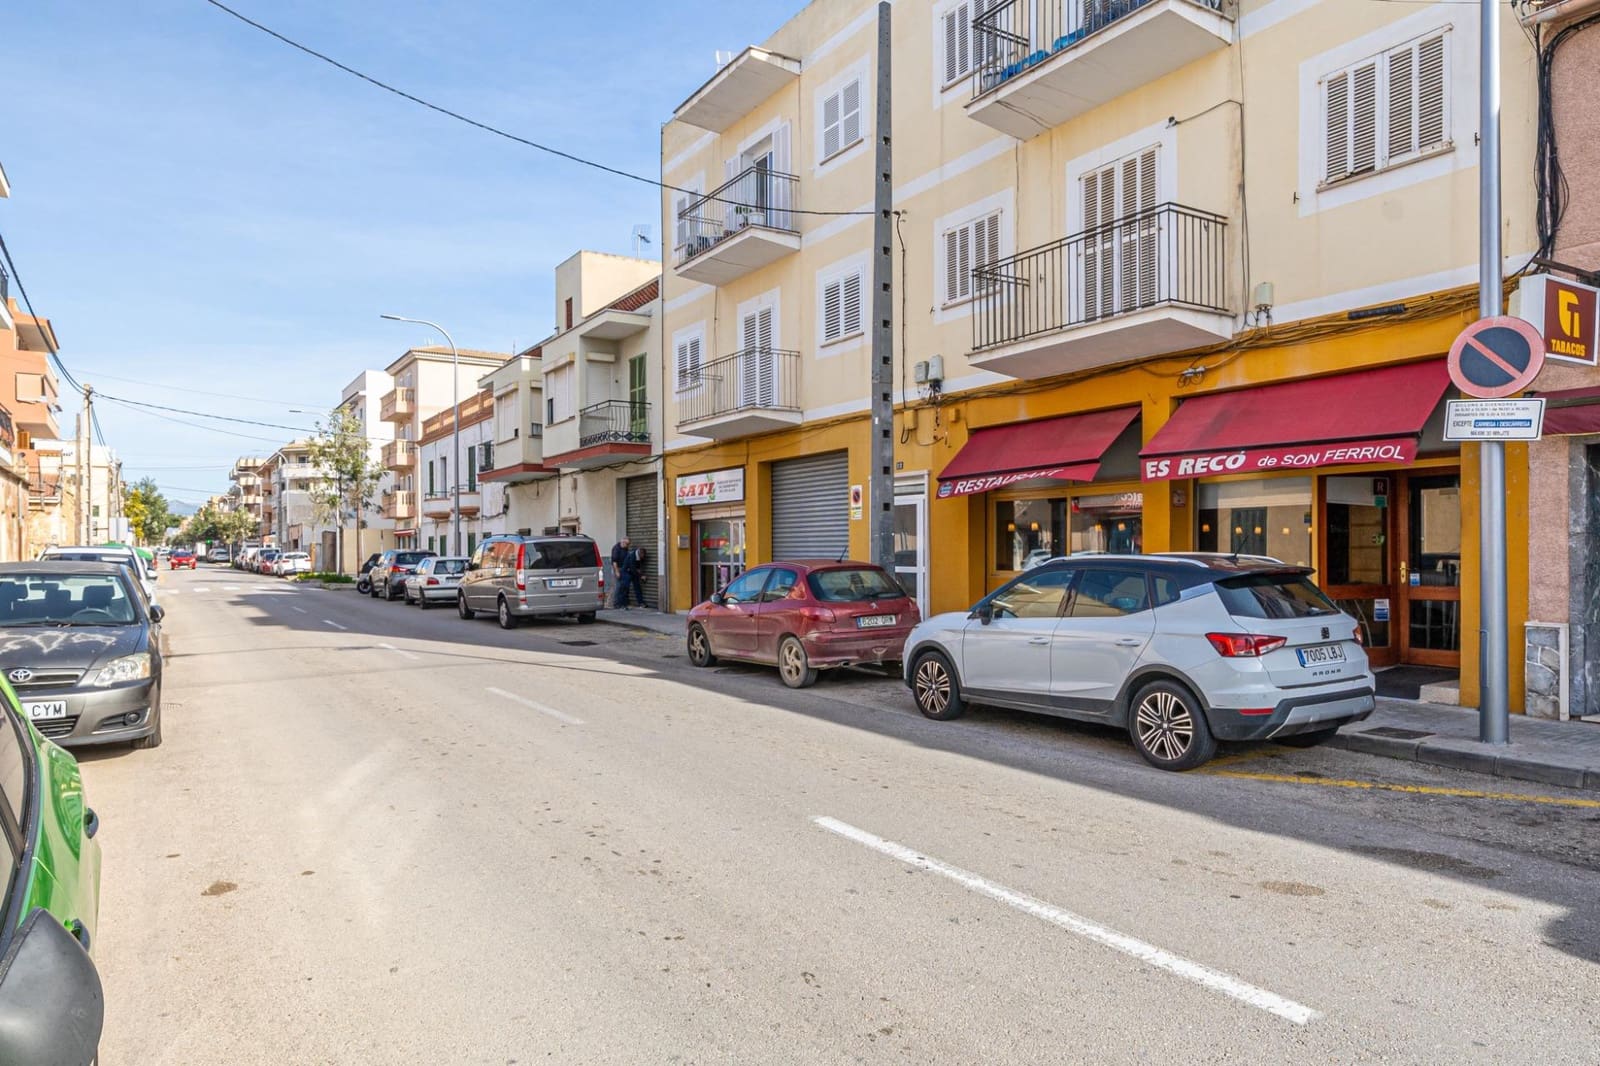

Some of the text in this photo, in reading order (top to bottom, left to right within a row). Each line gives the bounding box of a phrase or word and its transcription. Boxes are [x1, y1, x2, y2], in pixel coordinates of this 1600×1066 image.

[1551, 339, 1586, 357] TABACOS
[1146, 445, 1406, 479] ES RECÓ de SON FERRIOL
[678, 482, 715, 497] SATI
[1303, 646, 1343, 663] 7005 LBJ
[32, 703, 62, 717] CYM
